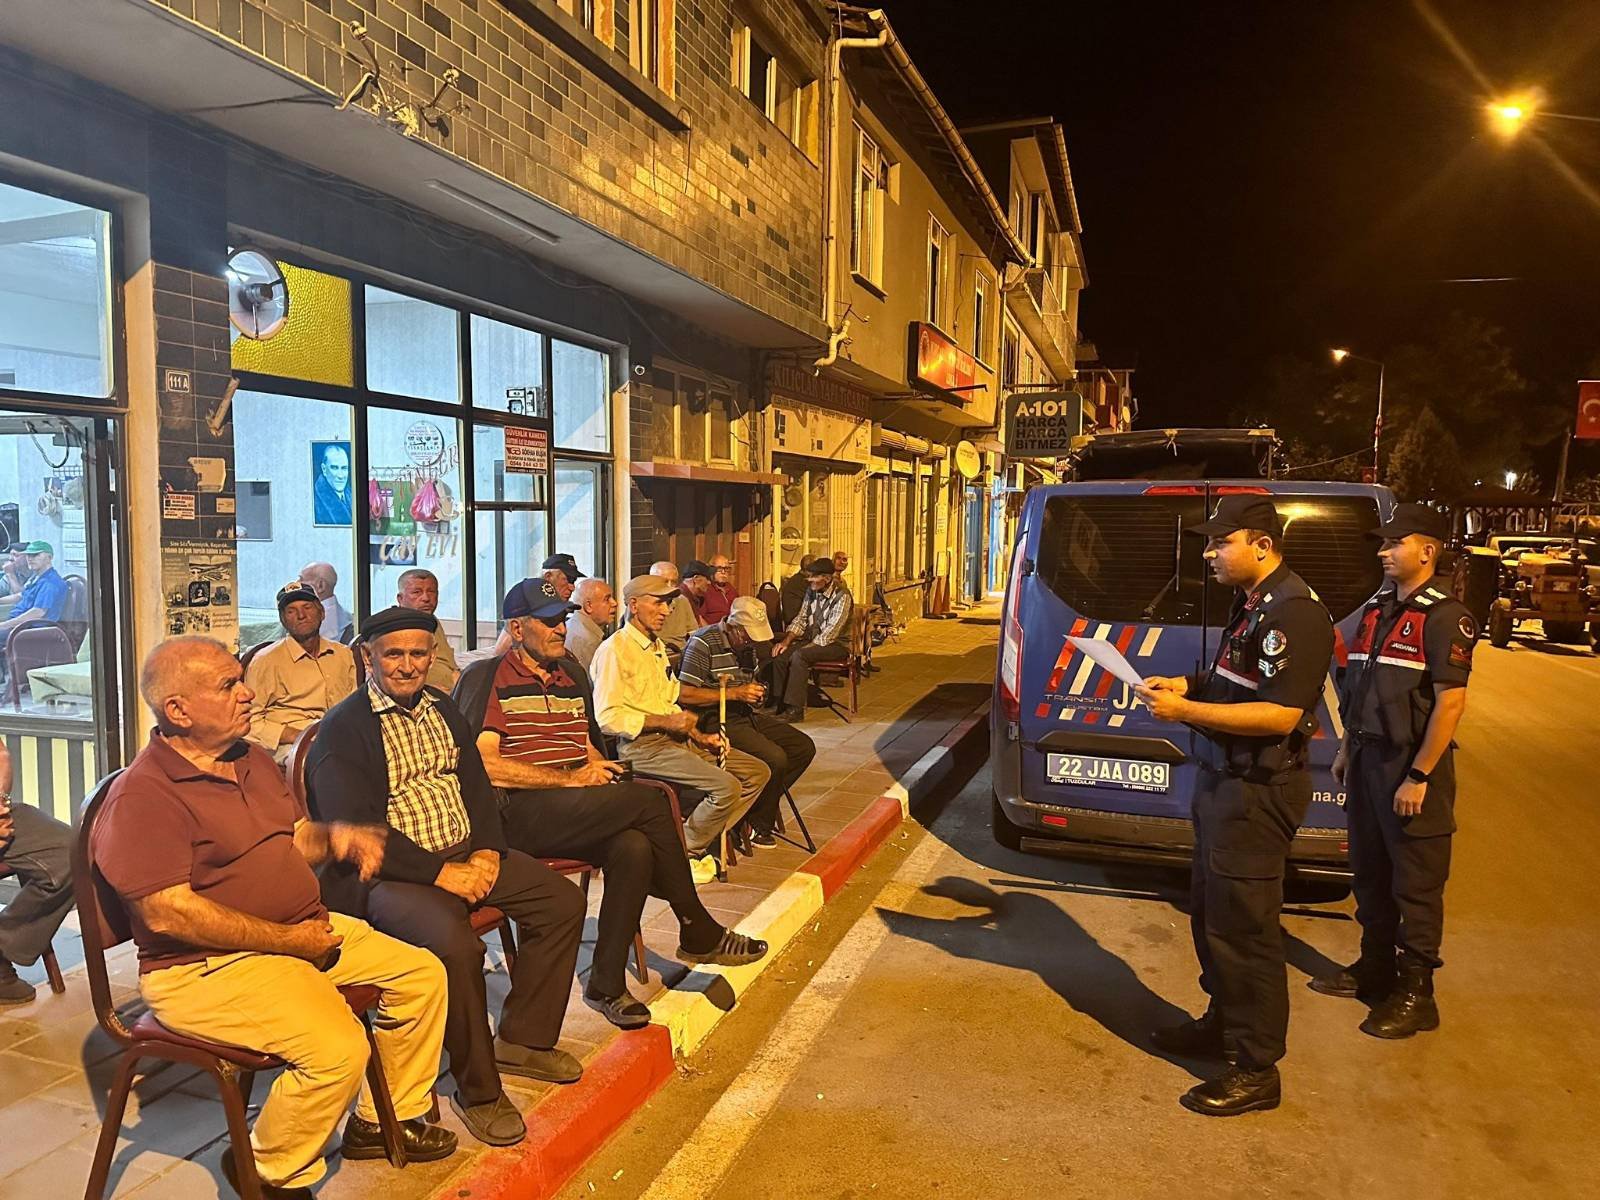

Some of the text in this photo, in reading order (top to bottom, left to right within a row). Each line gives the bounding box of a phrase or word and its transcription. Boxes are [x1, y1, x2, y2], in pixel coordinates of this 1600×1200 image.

[170, 376, 189, 389] 111 A
[1016, 417, 1067, 428] HARCA
[1016, 428, 1067, 438] HARCA
[1059, 757, 1165, 784] 22 JAA 089
